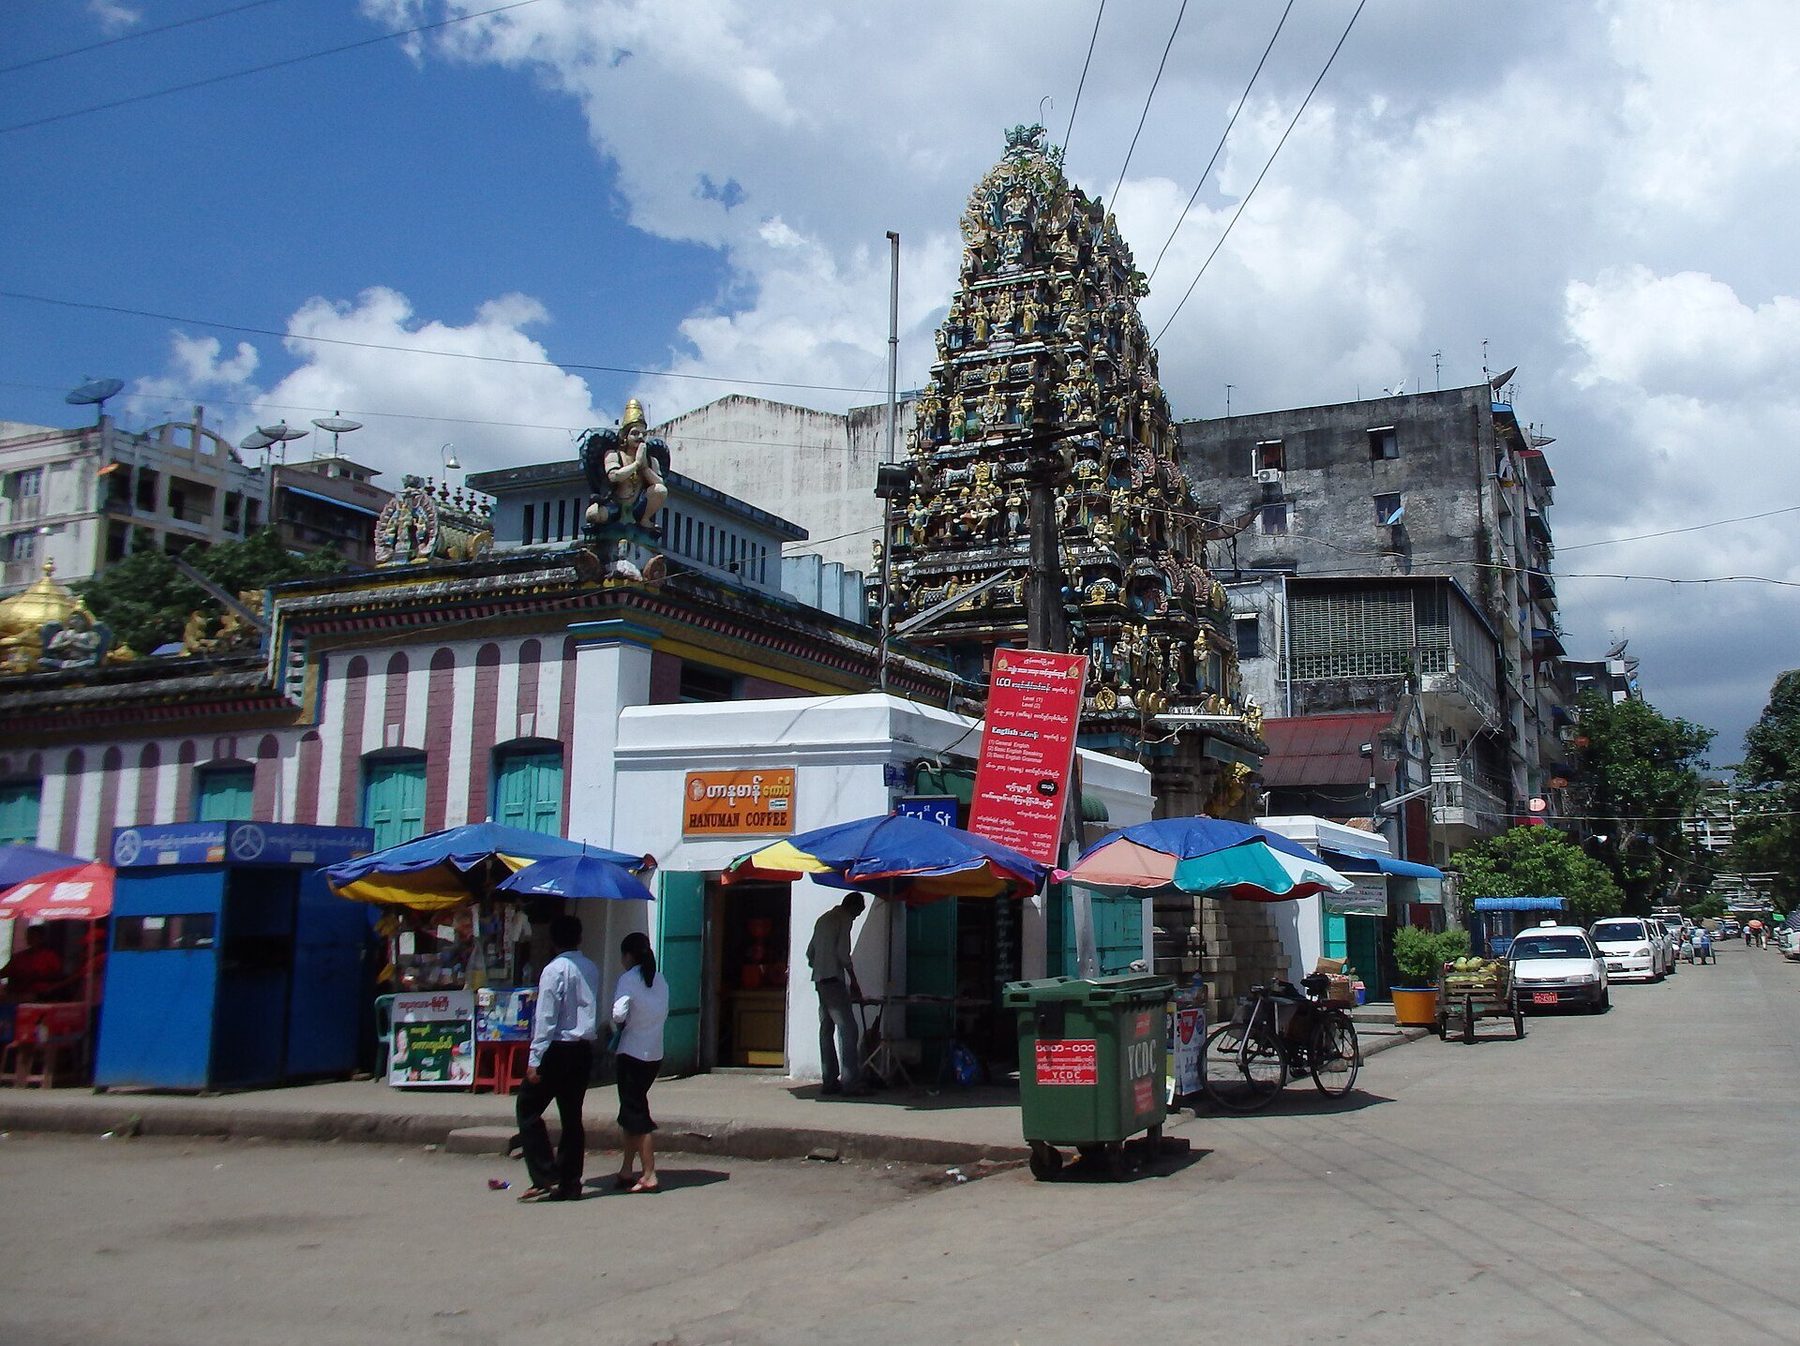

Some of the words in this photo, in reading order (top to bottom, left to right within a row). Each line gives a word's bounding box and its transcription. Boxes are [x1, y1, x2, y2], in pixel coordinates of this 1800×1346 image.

[991, 726, 1018, 736] English
[1013, 741, 1030, 749] English
[1006, 747, 1022, 755] English
[1005, 753, 1021, 761] English
[689, 813, 740, 828] HANUMAN
[745, 811, 787, 827] COFFEE
[935, 811, 951, 827] St
[1128, 1039, 1157, 1081] YCDC
[1052, 1071, 1081, 1079] YCDC
